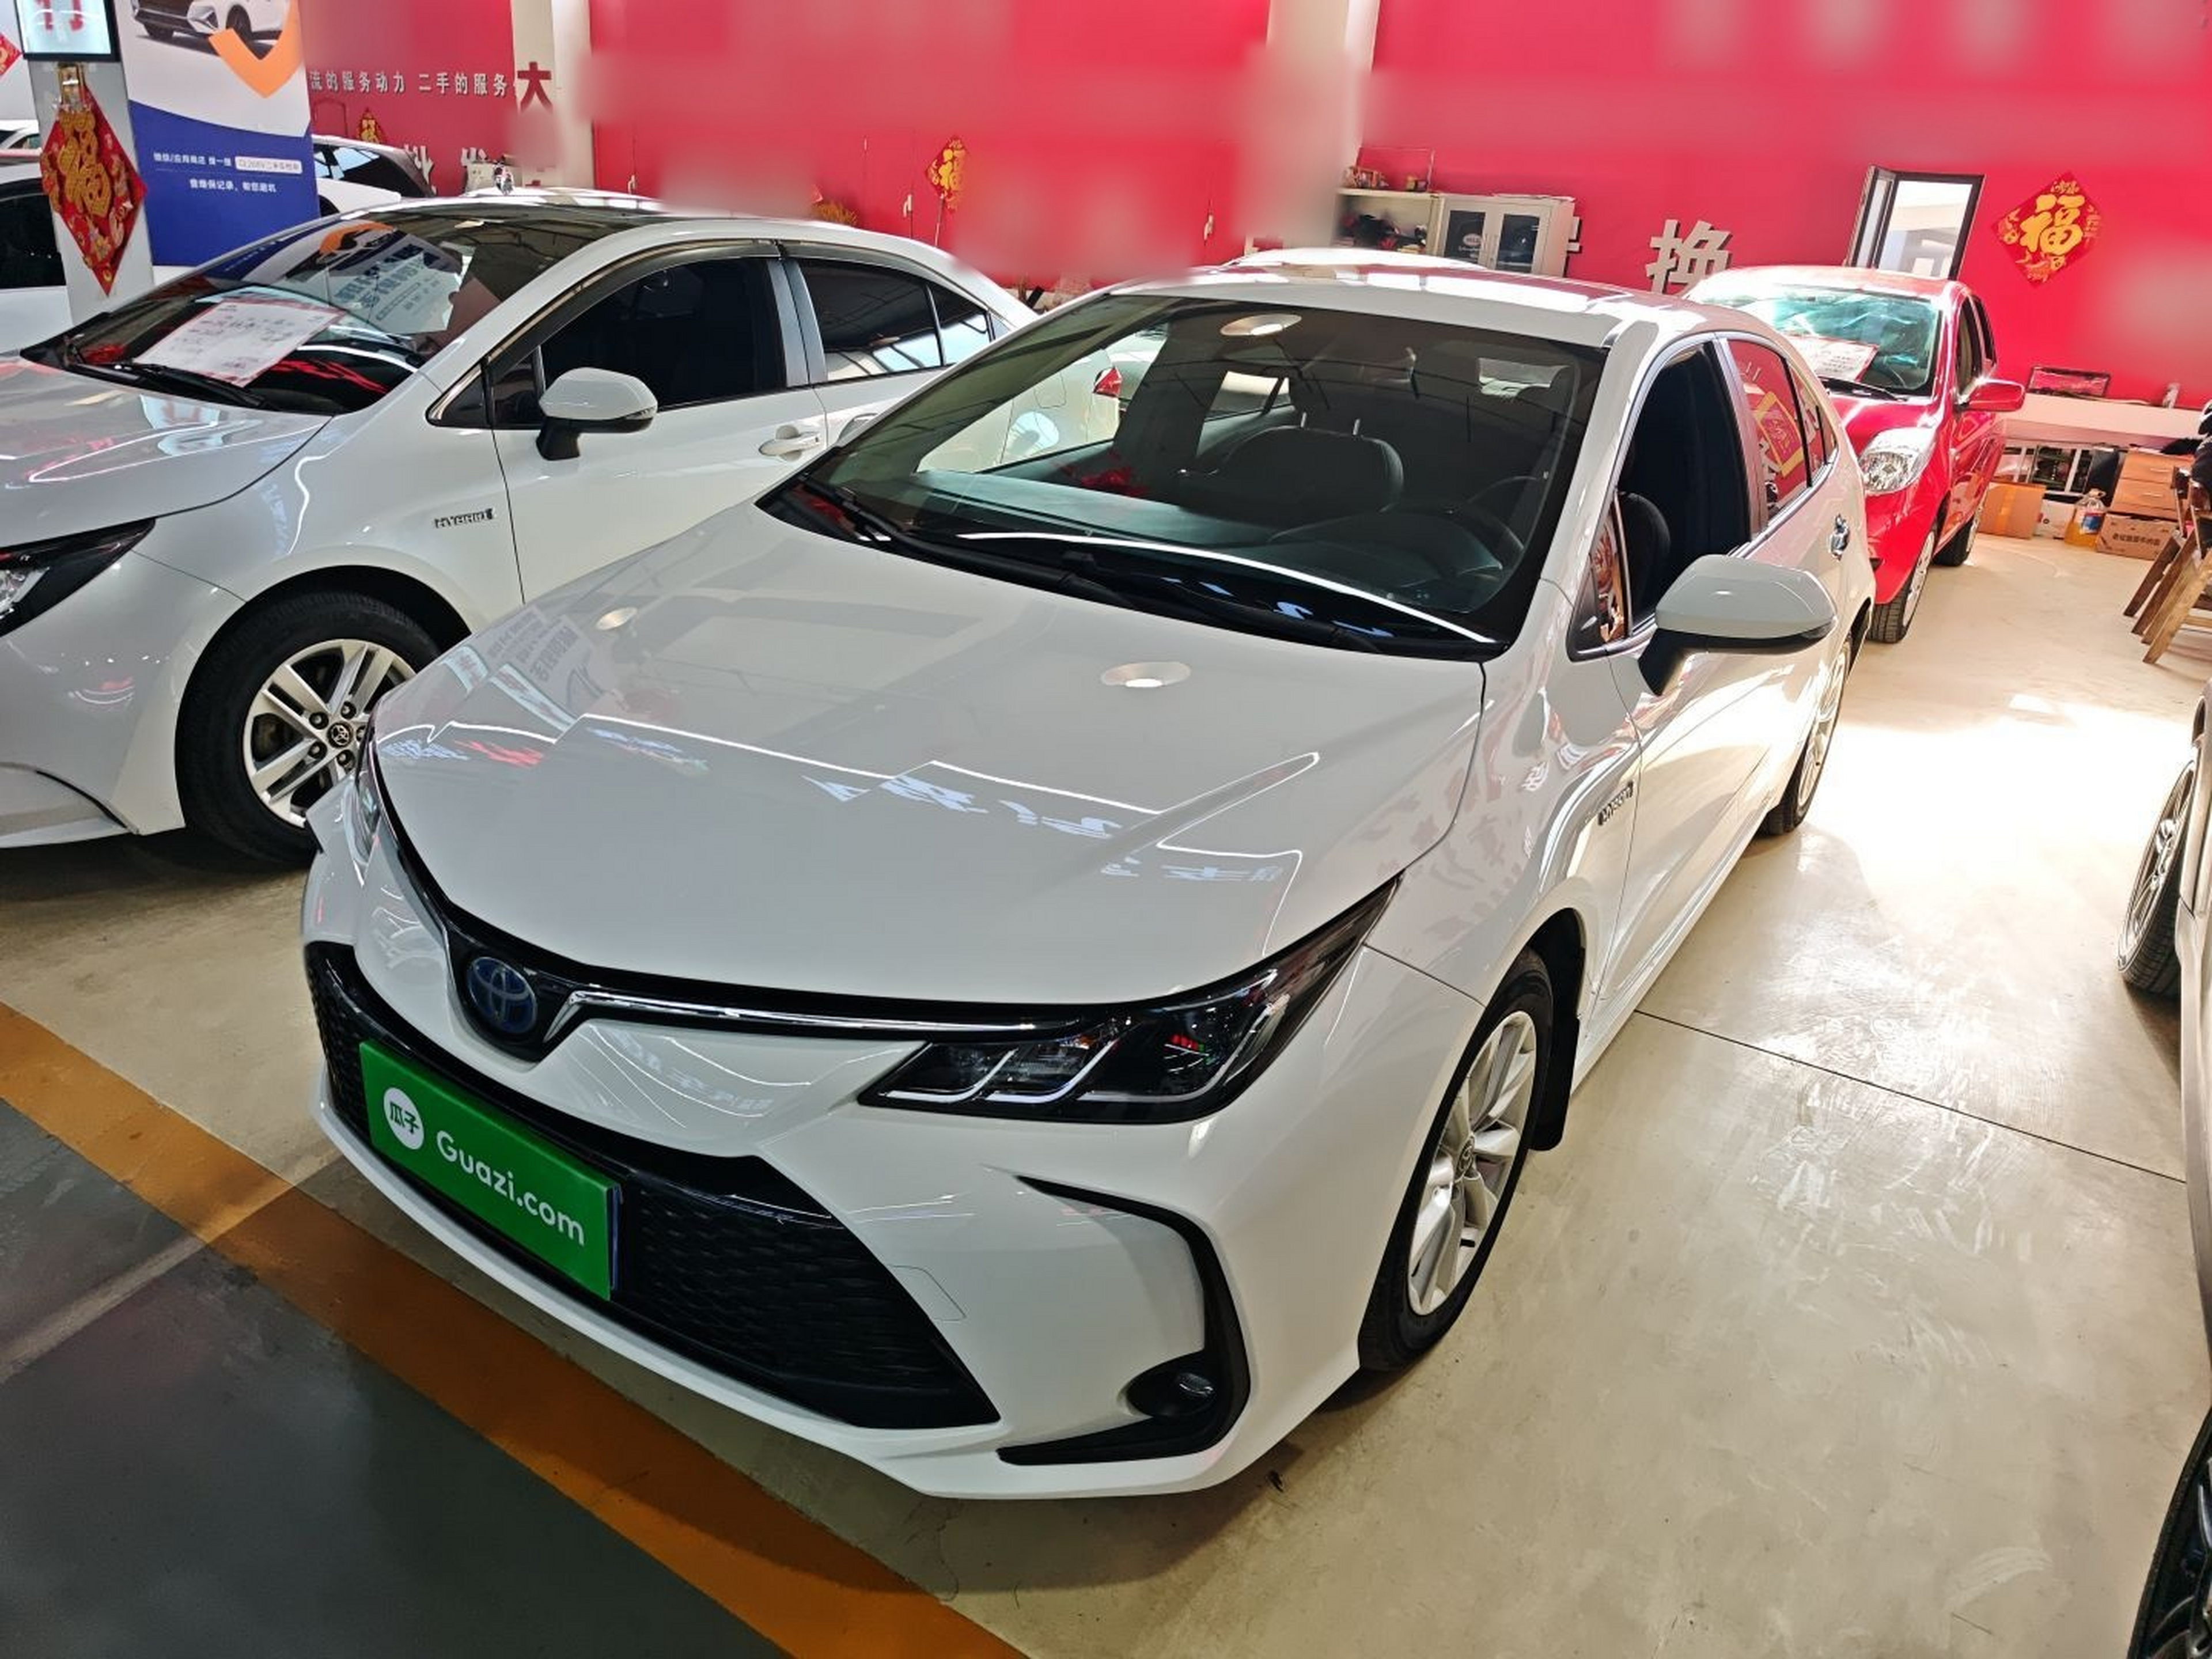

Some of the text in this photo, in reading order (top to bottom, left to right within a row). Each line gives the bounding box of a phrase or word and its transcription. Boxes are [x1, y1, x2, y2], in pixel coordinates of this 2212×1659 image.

[419, 73, 517, 97] 二手的服务
[2020, 194, 2085, 255] 福
[390, 1102, 419, 1135] 瓜子
[436, 1130, 585, 1247] Guazi.com
